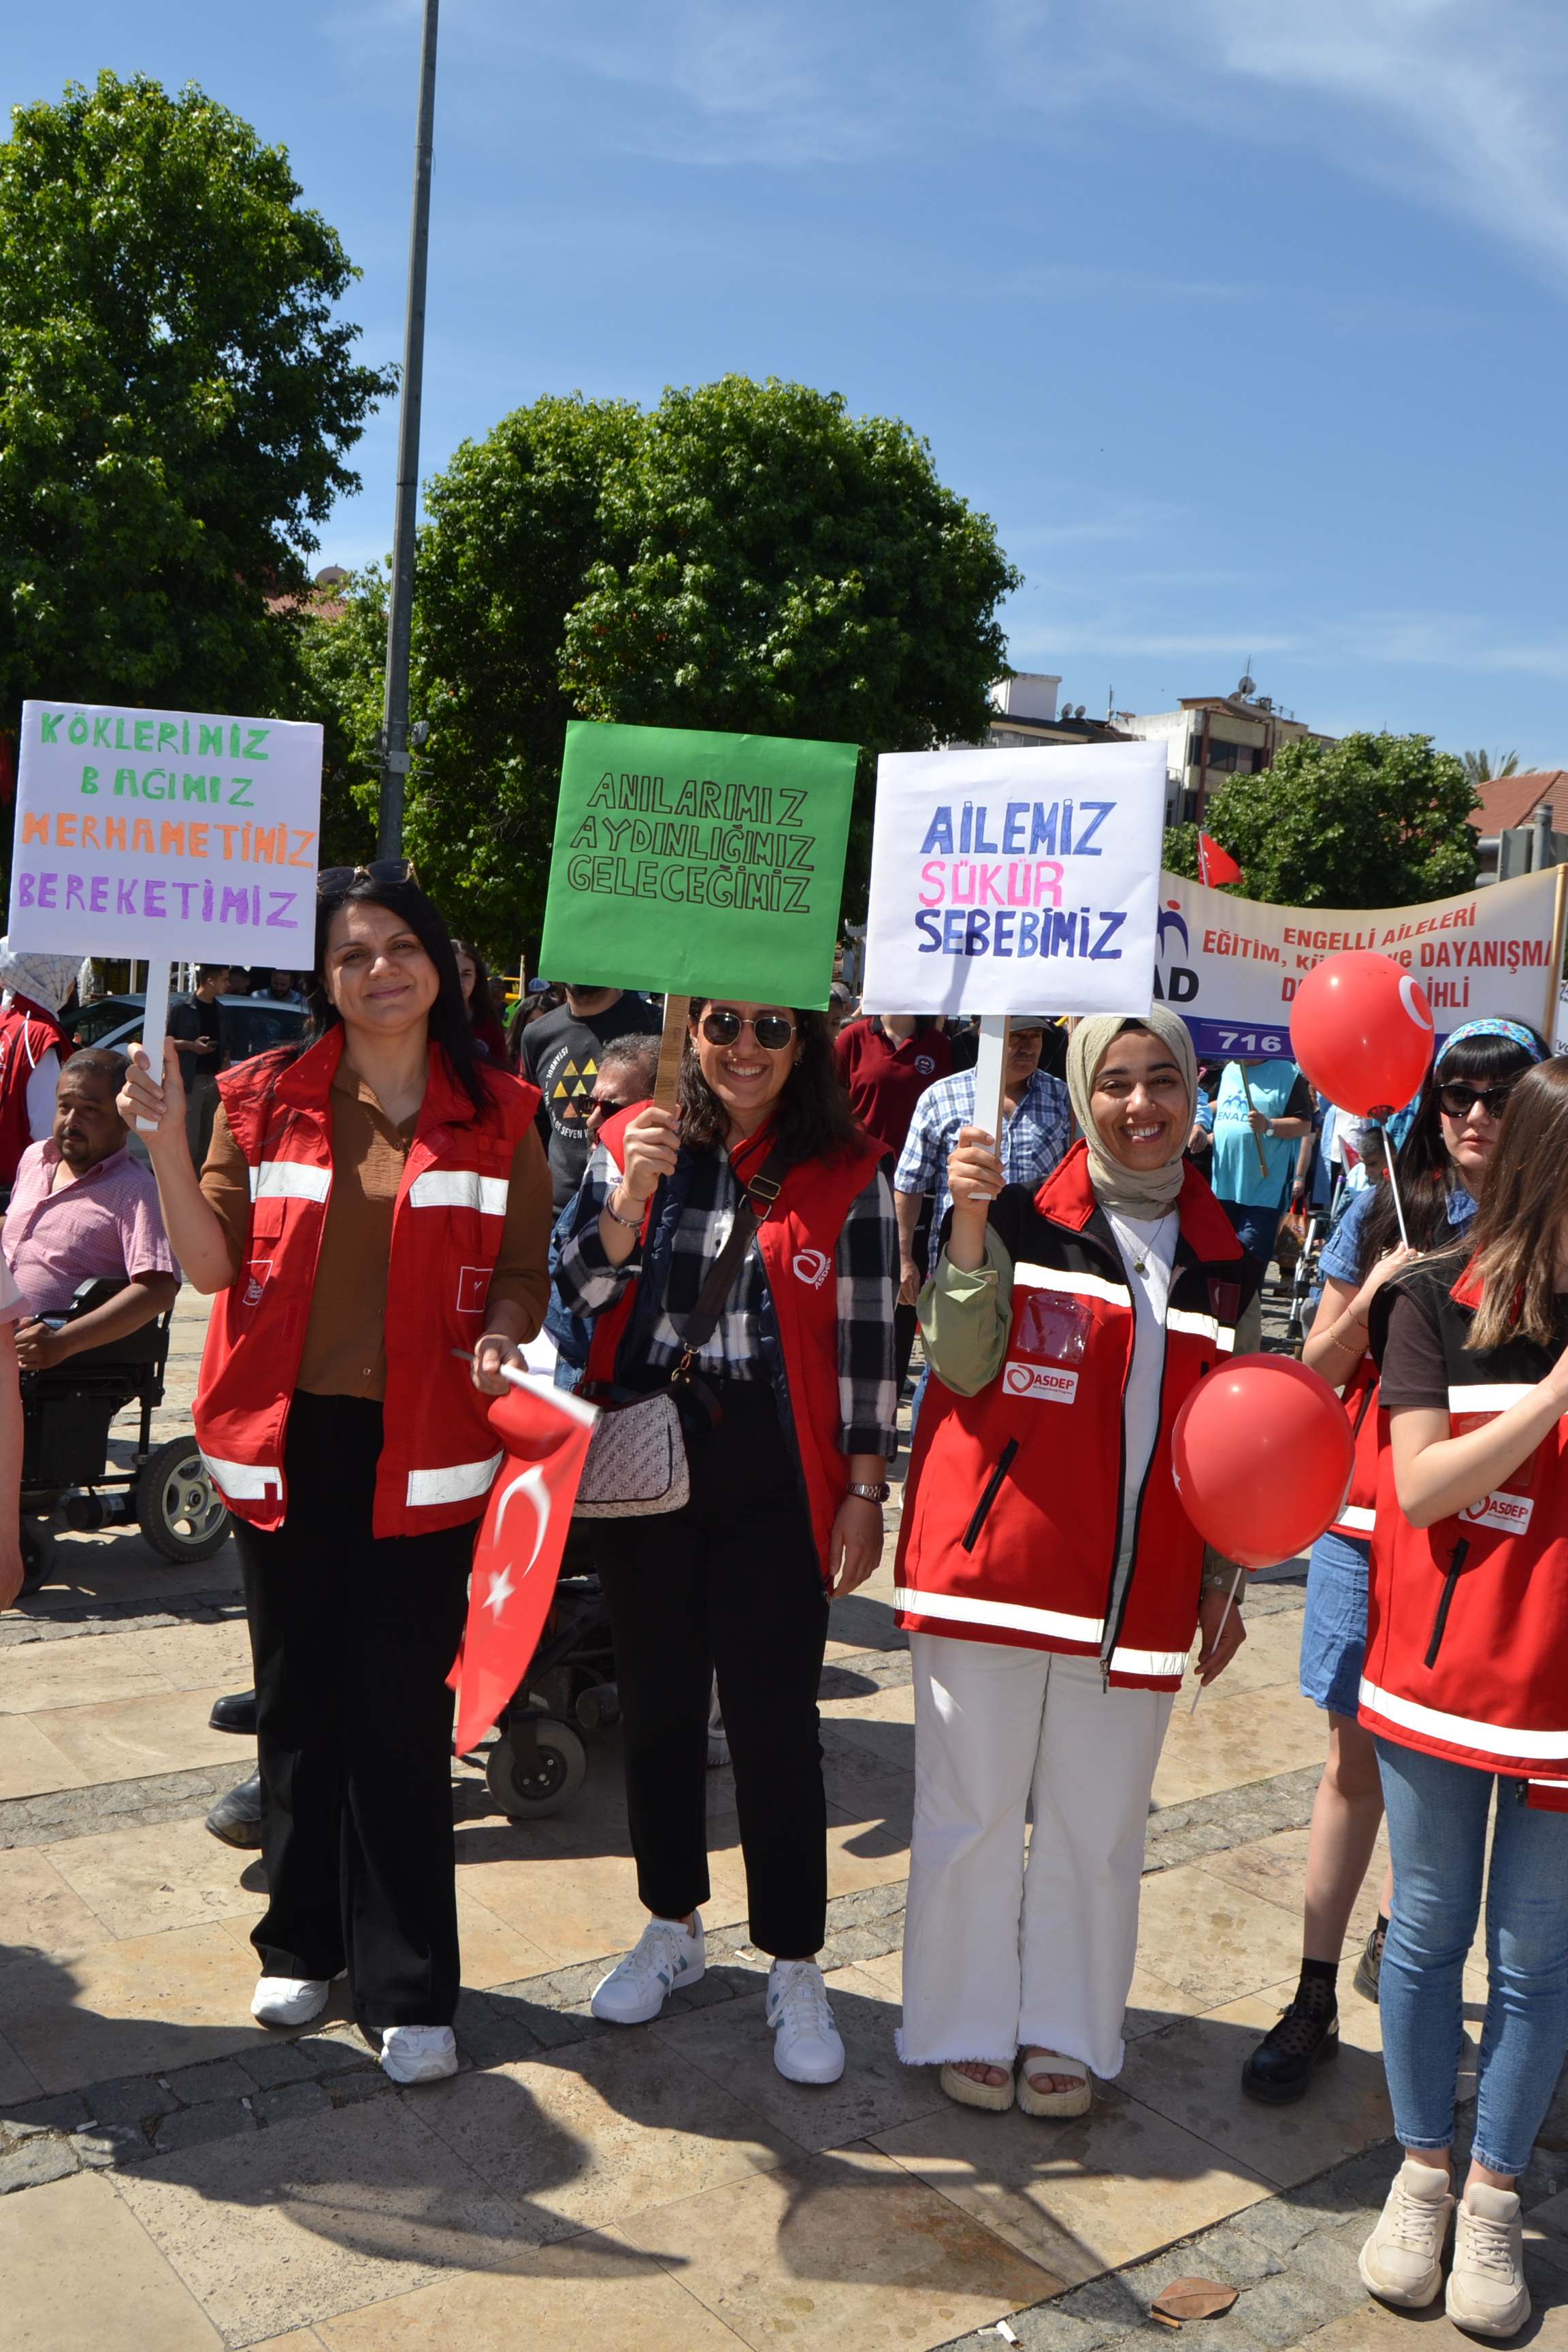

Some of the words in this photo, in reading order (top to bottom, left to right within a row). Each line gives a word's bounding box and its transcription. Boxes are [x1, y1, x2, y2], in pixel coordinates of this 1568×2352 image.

[41, 713, 270, 760] KÖKLERİMİZ
[587, 772, 808, 827] ANILARIMIZ
[22, 812, 316, 868] MERHAMETİMİZ
[570, 815, 815, 871] AYDINLIĞIMIZ
[919, 798, 1117, 855] AİLEMİZ
[18, 872, 298, 928] BEREKETİMİZ
[568, 854, 811, 913] GELECEĞİMİZ
[915, 907, 1128, 961] SEBEBİMİZ
[1203, 929, 1287, 968] EĞİTİM,
[1284, 928, 1376, 950] ENGELLİ
[1381, 902, 1477, 947] AİLELERİ
[1218, 1031, 1281, 1052] 716
[560, 1126, 583, 1139] SEVEN
[1034, 1373, 1075, 1390] ASDEP
[1488, 1500, 1529, 1519] ASDEP
